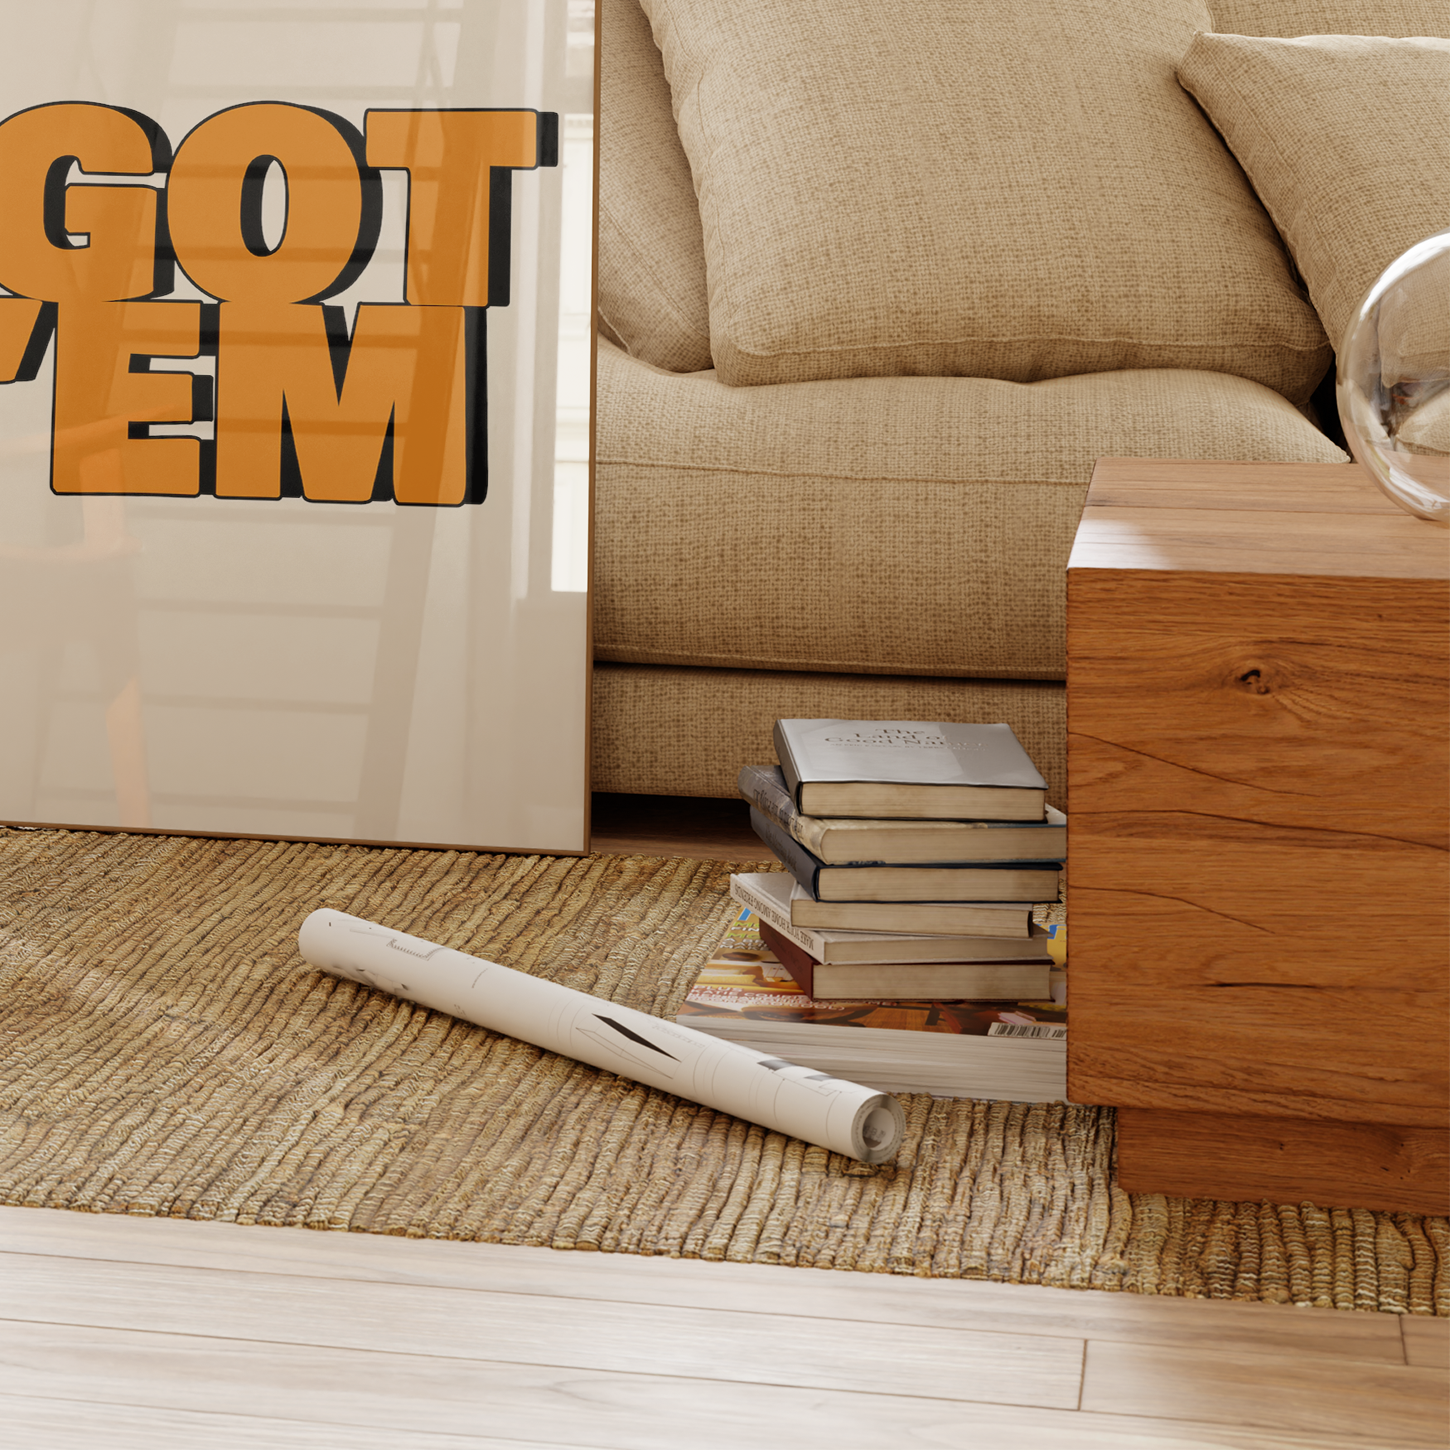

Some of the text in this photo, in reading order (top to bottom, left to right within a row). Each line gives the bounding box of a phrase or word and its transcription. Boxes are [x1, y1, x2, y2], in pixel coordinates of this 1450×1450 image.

[824, 736, 894, 745] Good
[735, 884, 754, 908] FRIENDS
[754, 898, 771, 918] AMONG
[772, 910, 787, 930] HOME
[800, 930, 814, 951] MAKE
